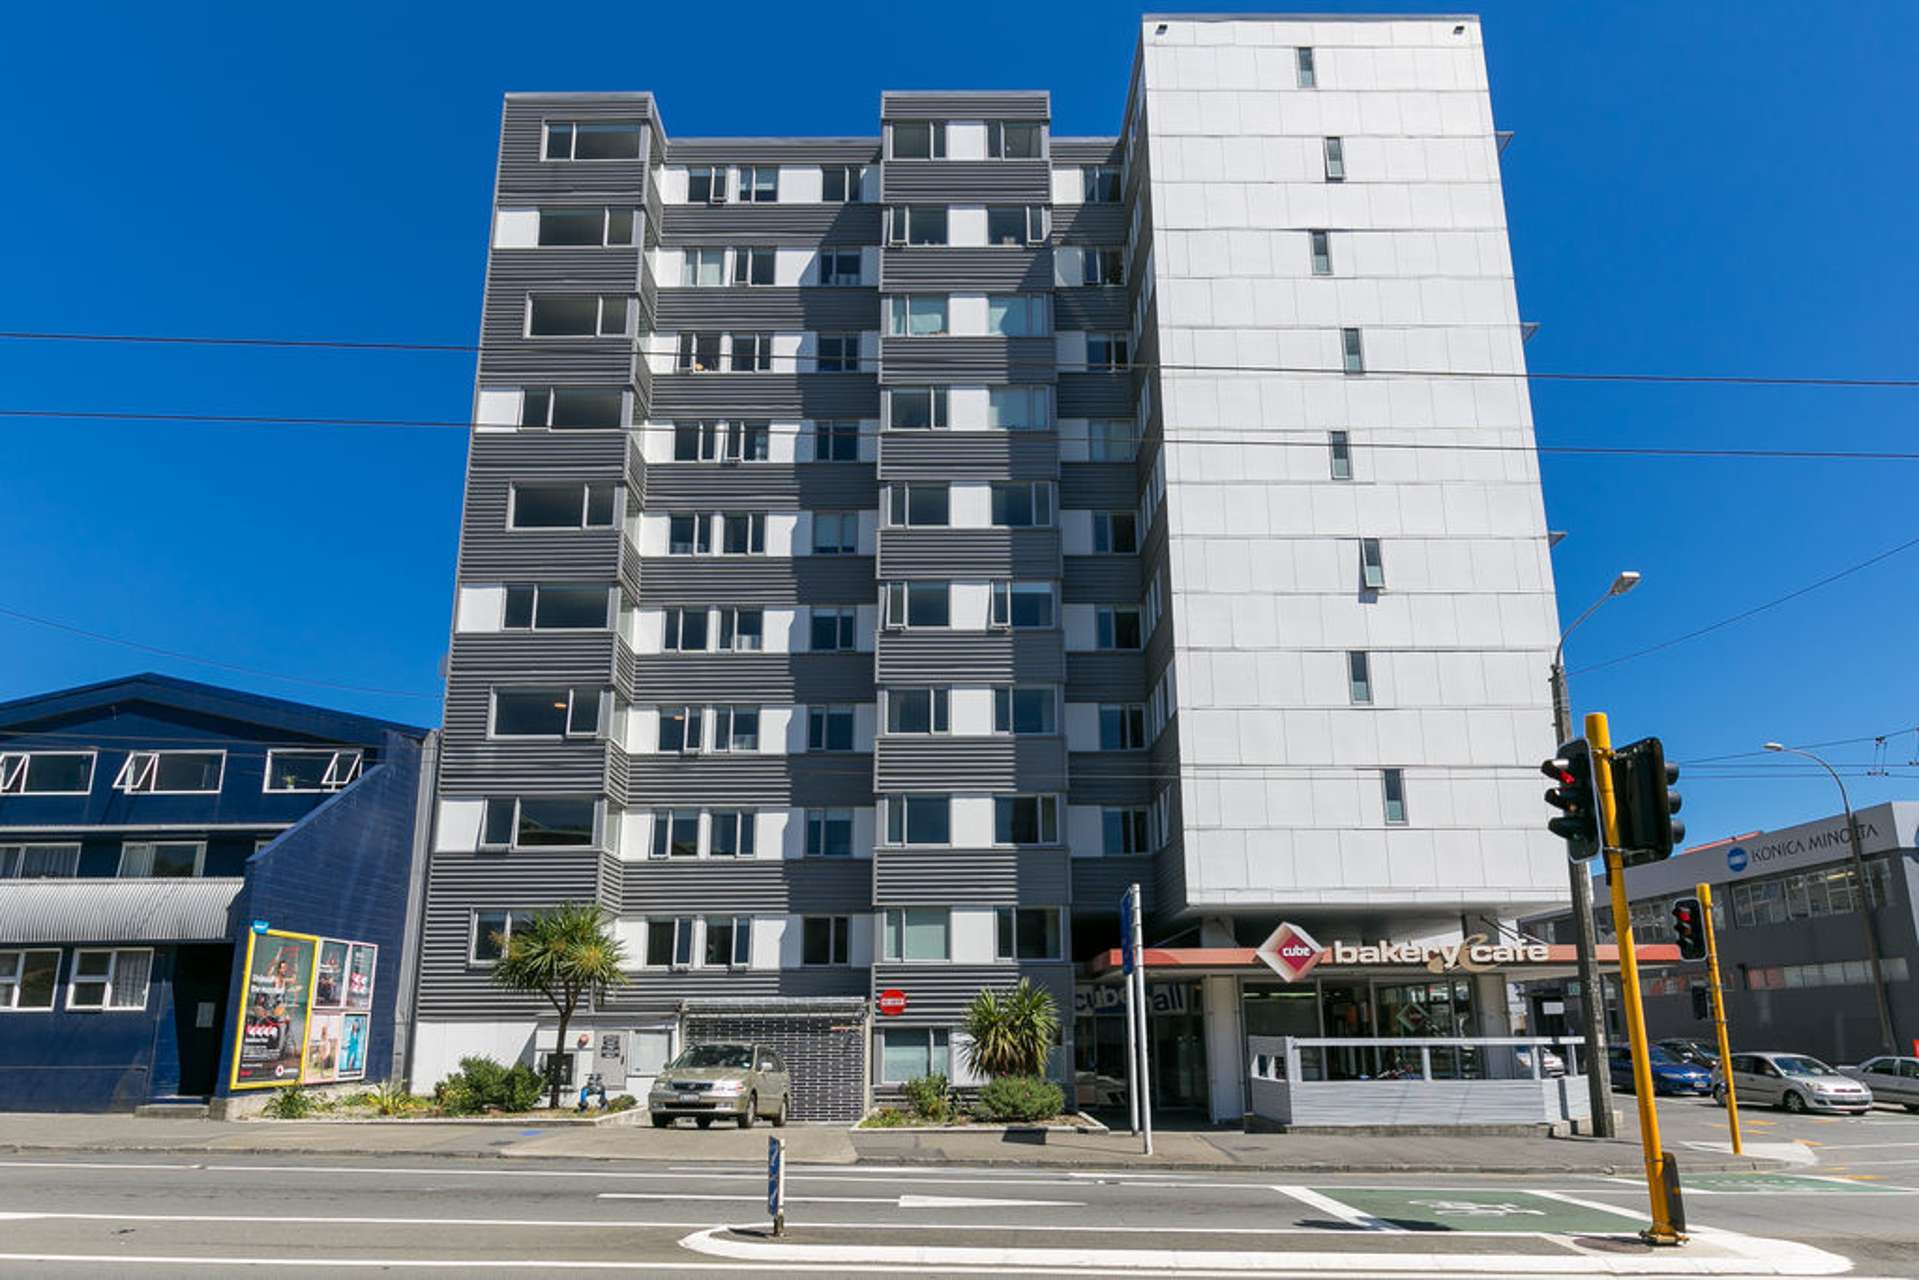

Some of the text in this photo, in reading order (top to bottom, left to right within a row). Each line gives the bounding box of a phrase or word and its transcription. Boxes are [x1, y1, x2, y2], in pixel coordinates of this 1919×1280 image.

[1751, 823, 1879, 862] KONICA MINOTA
[1282, 945, 1311, 957] cube
[1334, 938, 1550, 969] bakery cafe
